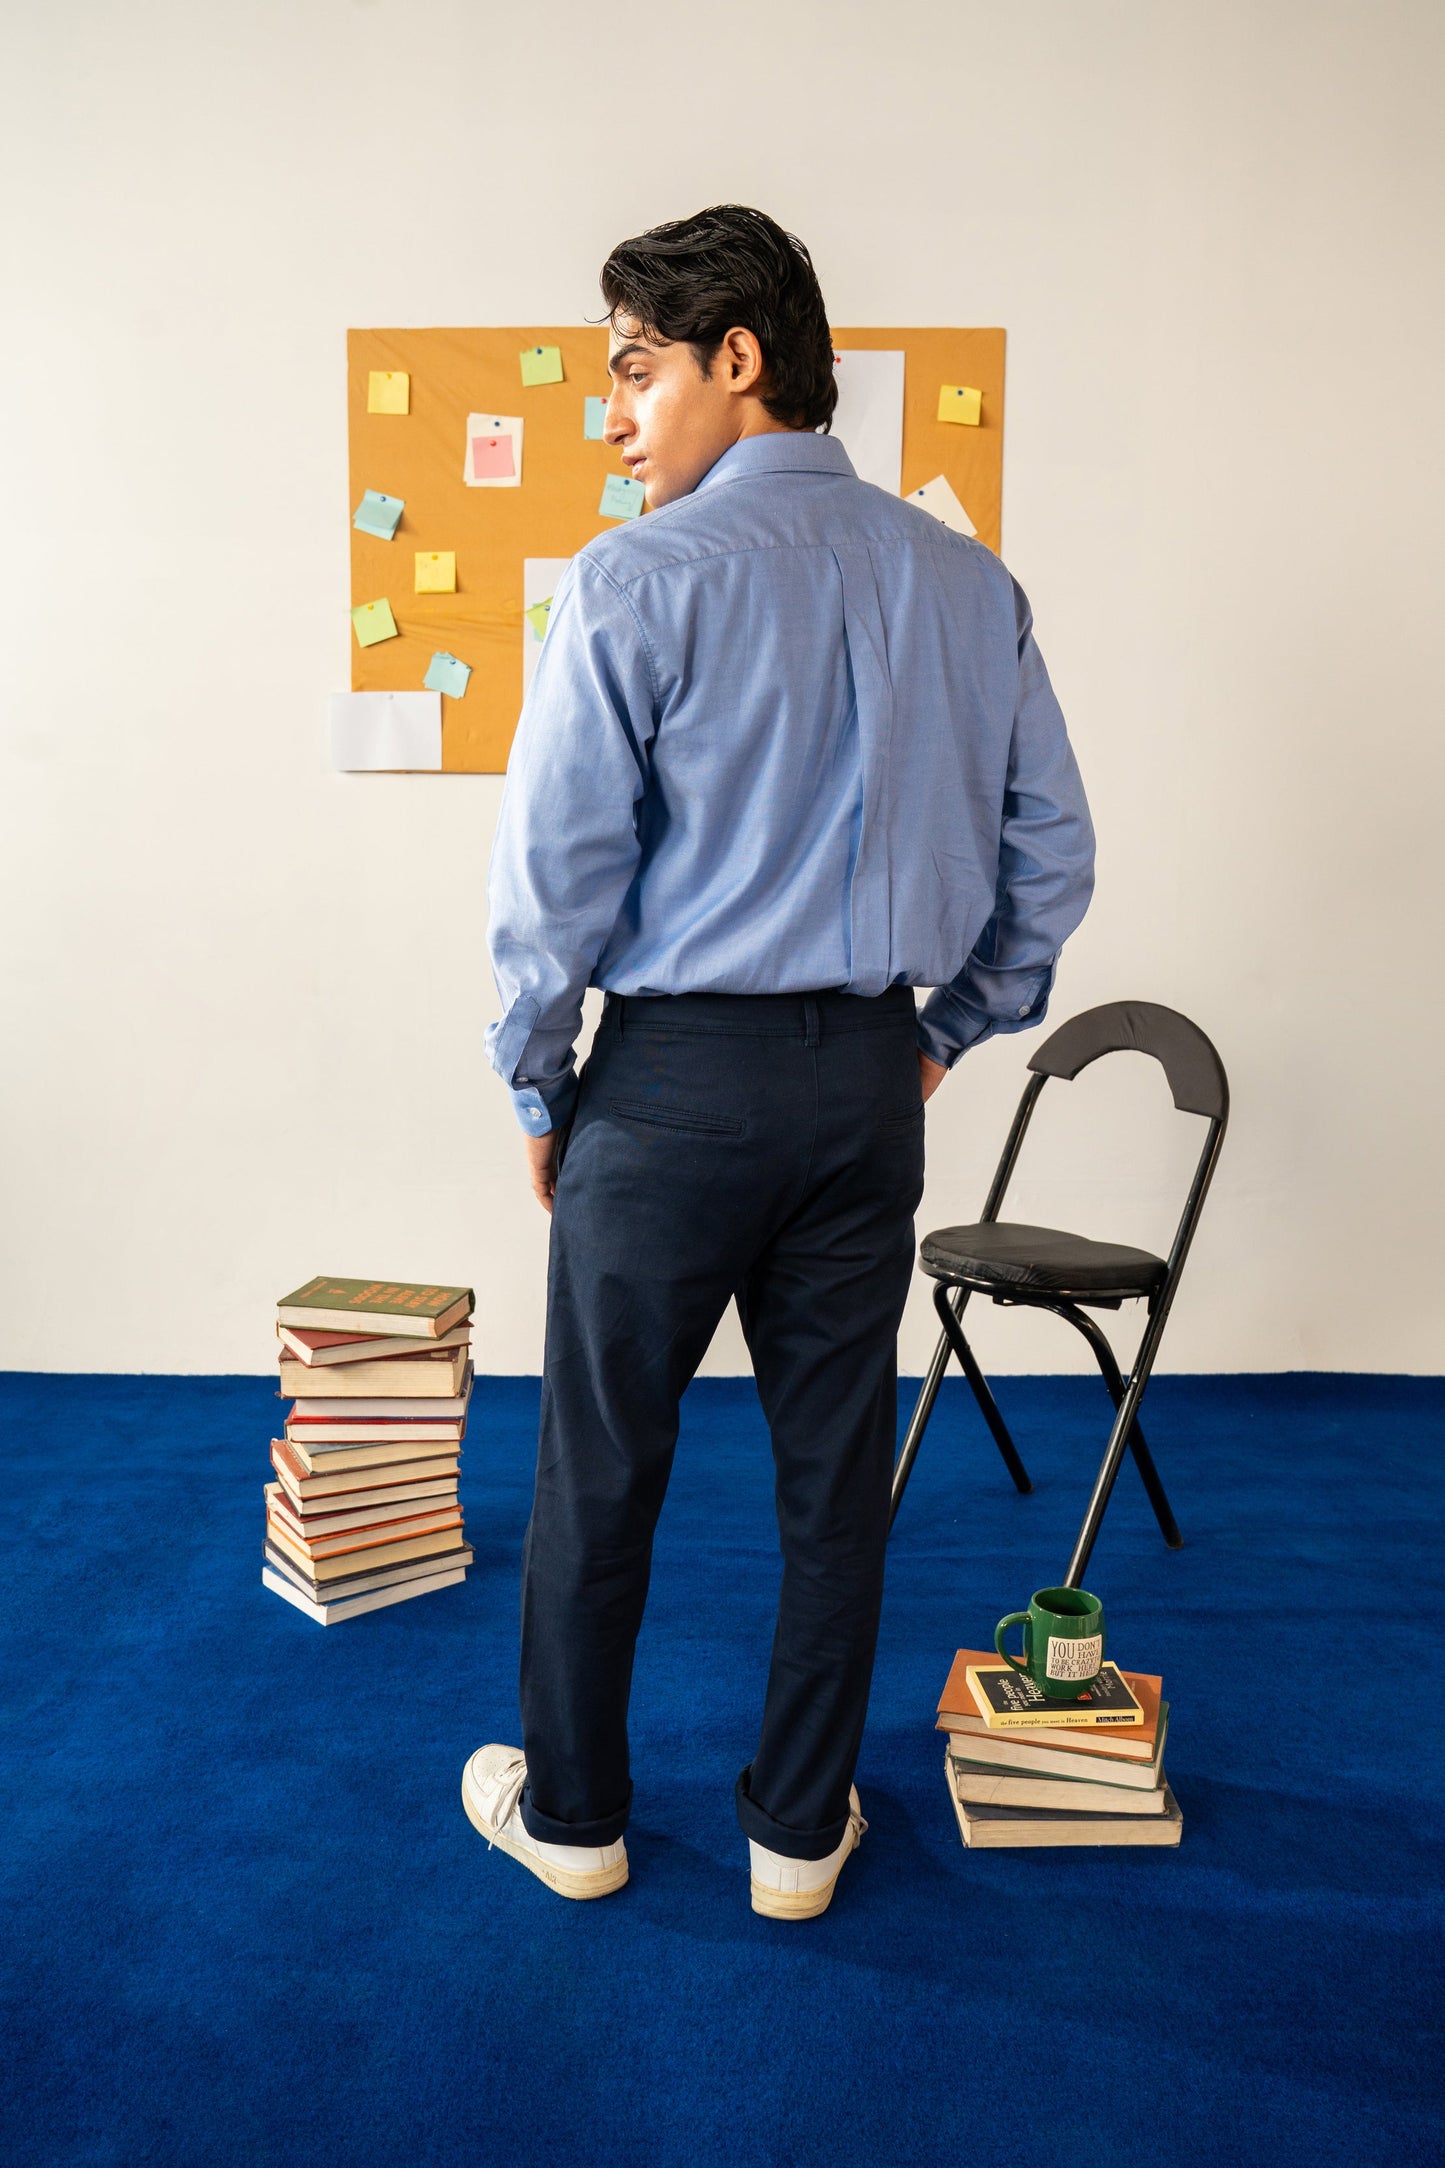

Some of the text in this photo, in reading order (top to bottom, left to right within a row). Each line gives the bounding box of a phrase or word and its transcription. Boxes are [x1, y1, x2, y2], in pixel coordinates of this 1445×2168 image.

[1051, 1640, 1075, 1659] YOU
[1050, 1663, 1073, 1672] WORK
[1050, 1669, 1065, 1677] BUT
[997, 1678, 1024, 1711] five people
[1020, 1718, 1041, 1726] people
